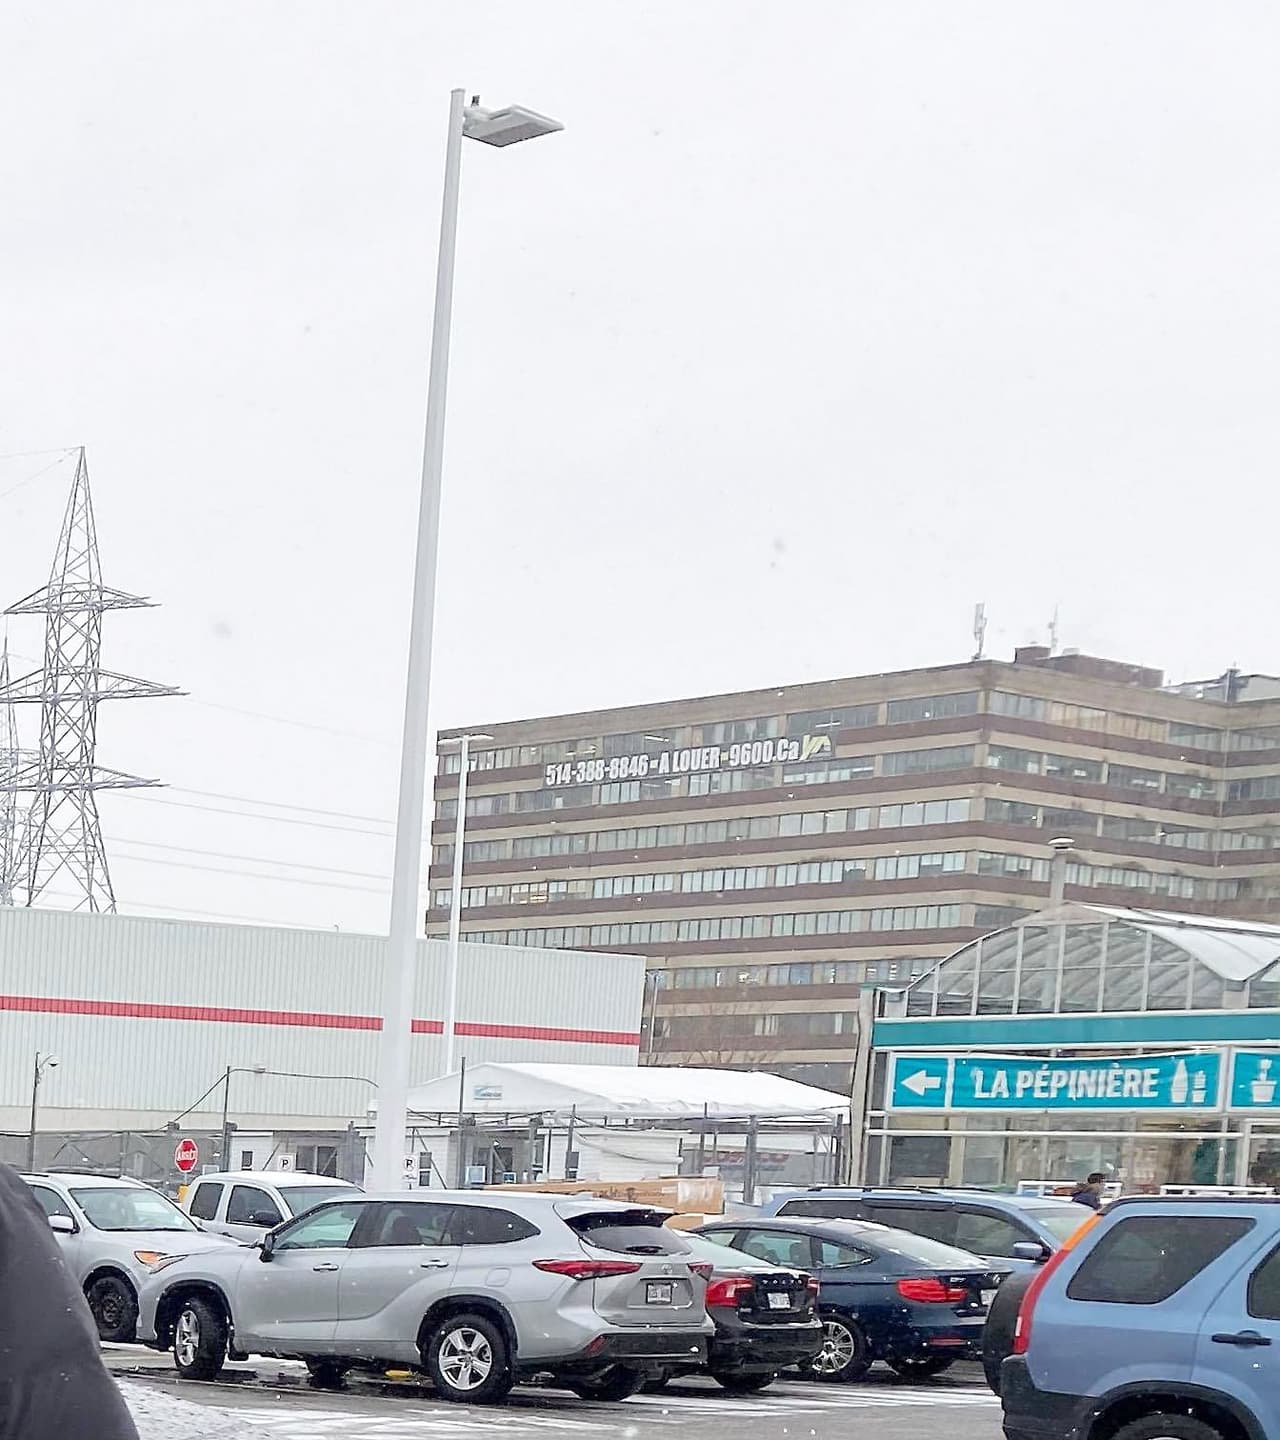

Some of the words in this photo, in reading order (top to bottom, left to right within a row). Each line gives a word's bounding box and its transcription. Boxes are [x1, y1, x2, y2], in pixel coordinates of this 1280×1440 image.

[546, 752, 649, 786] 514-388-8846
[673, 745, 720, 772] LOUER
[974, 1069, 1009, 1098] LA
[1016, 1063, 1160, 1100] PÉPINIÈRE
